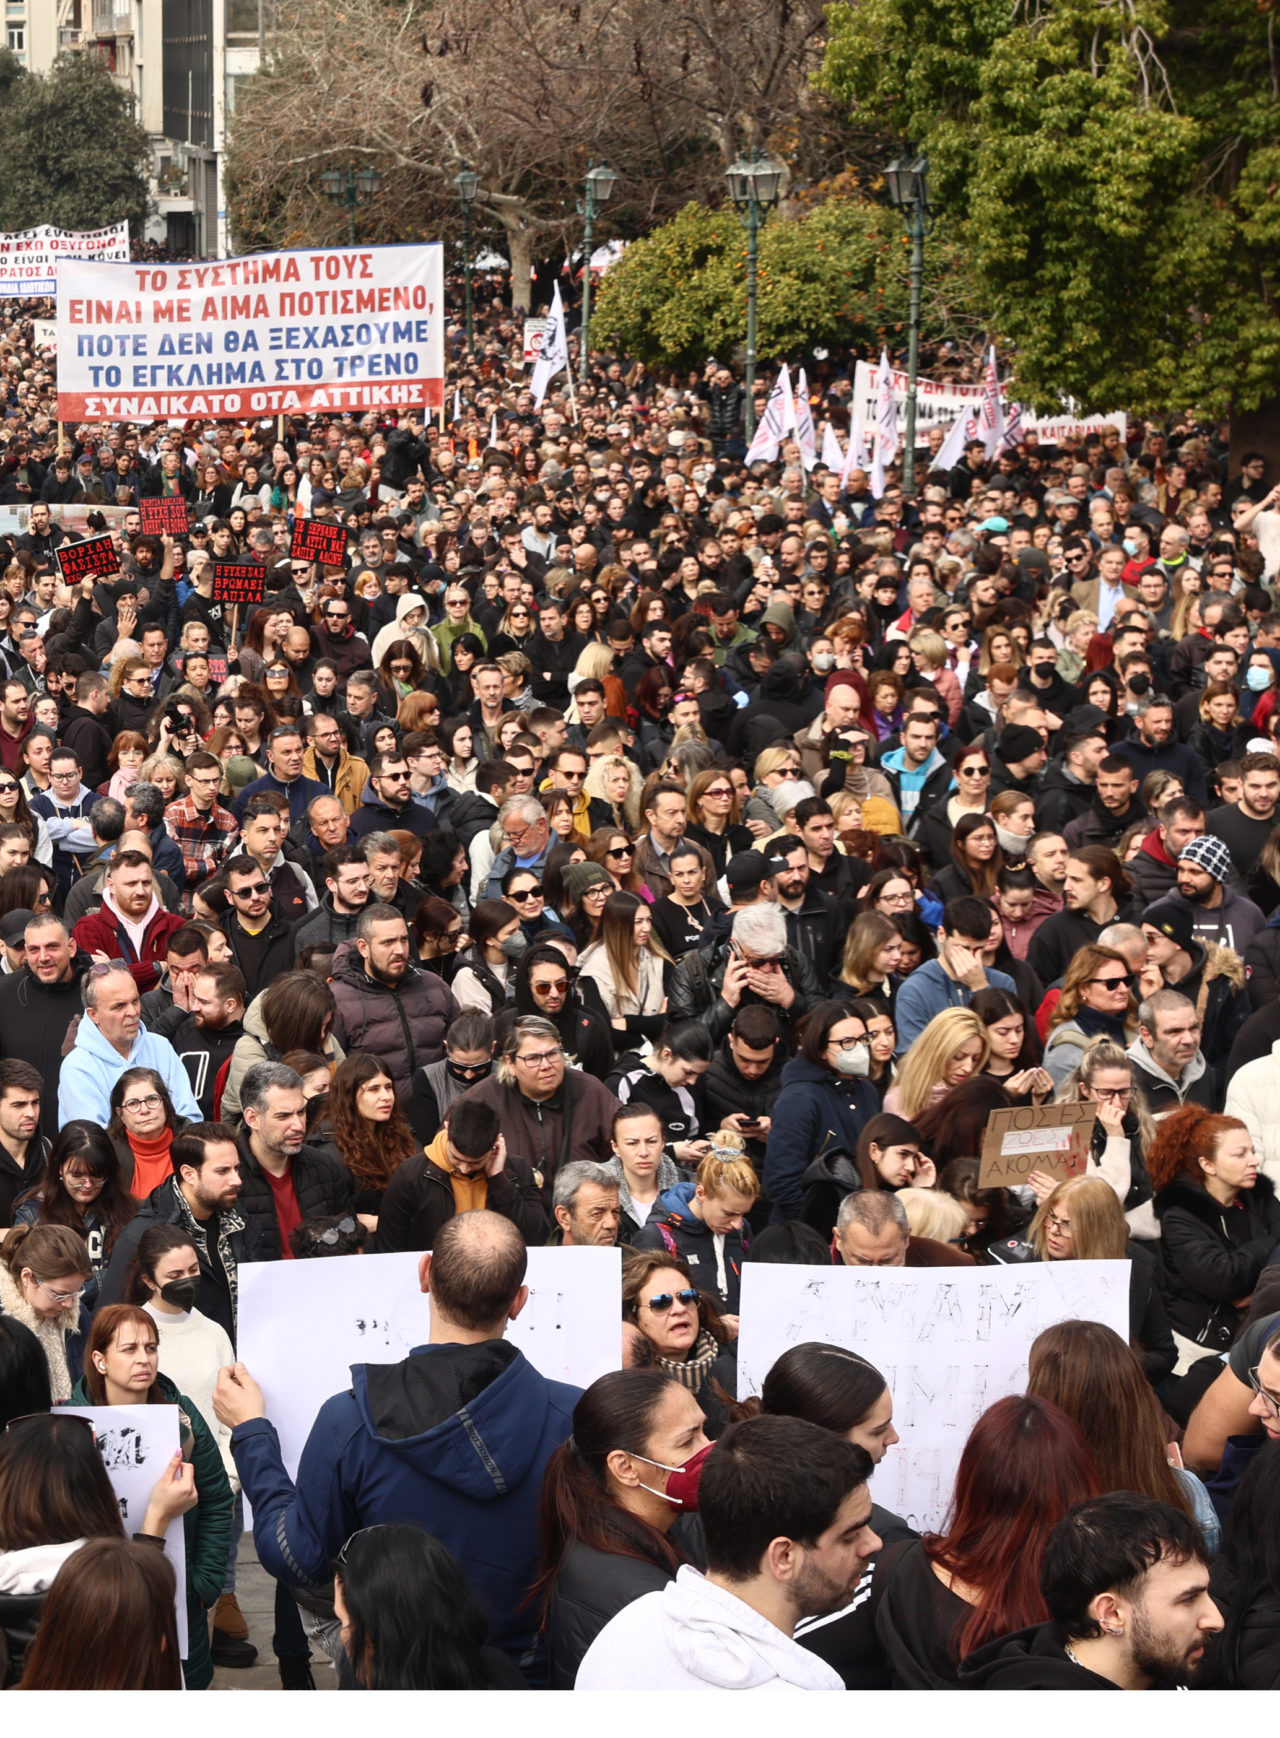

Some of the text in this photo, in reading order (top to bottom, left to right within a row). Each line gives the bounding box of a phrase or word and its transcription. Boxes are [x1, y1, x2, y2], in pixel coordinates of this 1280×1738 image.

[16, 240, 44, 251] ΕΧΩ
[135, 253, 374, 292] ΤΟ ΣΥΣΤΗΜΑ ΤΟΥΣ
[69, 284, 434, 325] ΕΙΝΑΙ ΜΕ ΑΙΜΑ ΠΟΤΙΣΜΕΝΟ,
[77, 320, 429, 358] ΠΟΤΕ ΔΕΝ ΘΑ ΞΕΧΑΣΟΥΜΕ
[88, 352, 419, 388] ΤΟ ΕΓΚΛΗΜΑ ΣΤΟ ΤΡΕΝΟ
[84, 383, 424, 417] ΣΥΝΔΙΚΑΤΟ ΟΤΑ ΑΤΤΙΚΗΣ
[59, 538, 112, 562] ΒΟΡΙΔΗ
[63, 550, 116, 574] ΦΑΣΙΣΤΑ
[216, 565, 265, 578] Η ΨΥΧΗ ΣΑΣ
[213, 589, 263, 603] ΣΑΠΙΛΑ
[214, 578, 264, 591] ΒΡΩΜΑΕΙ
